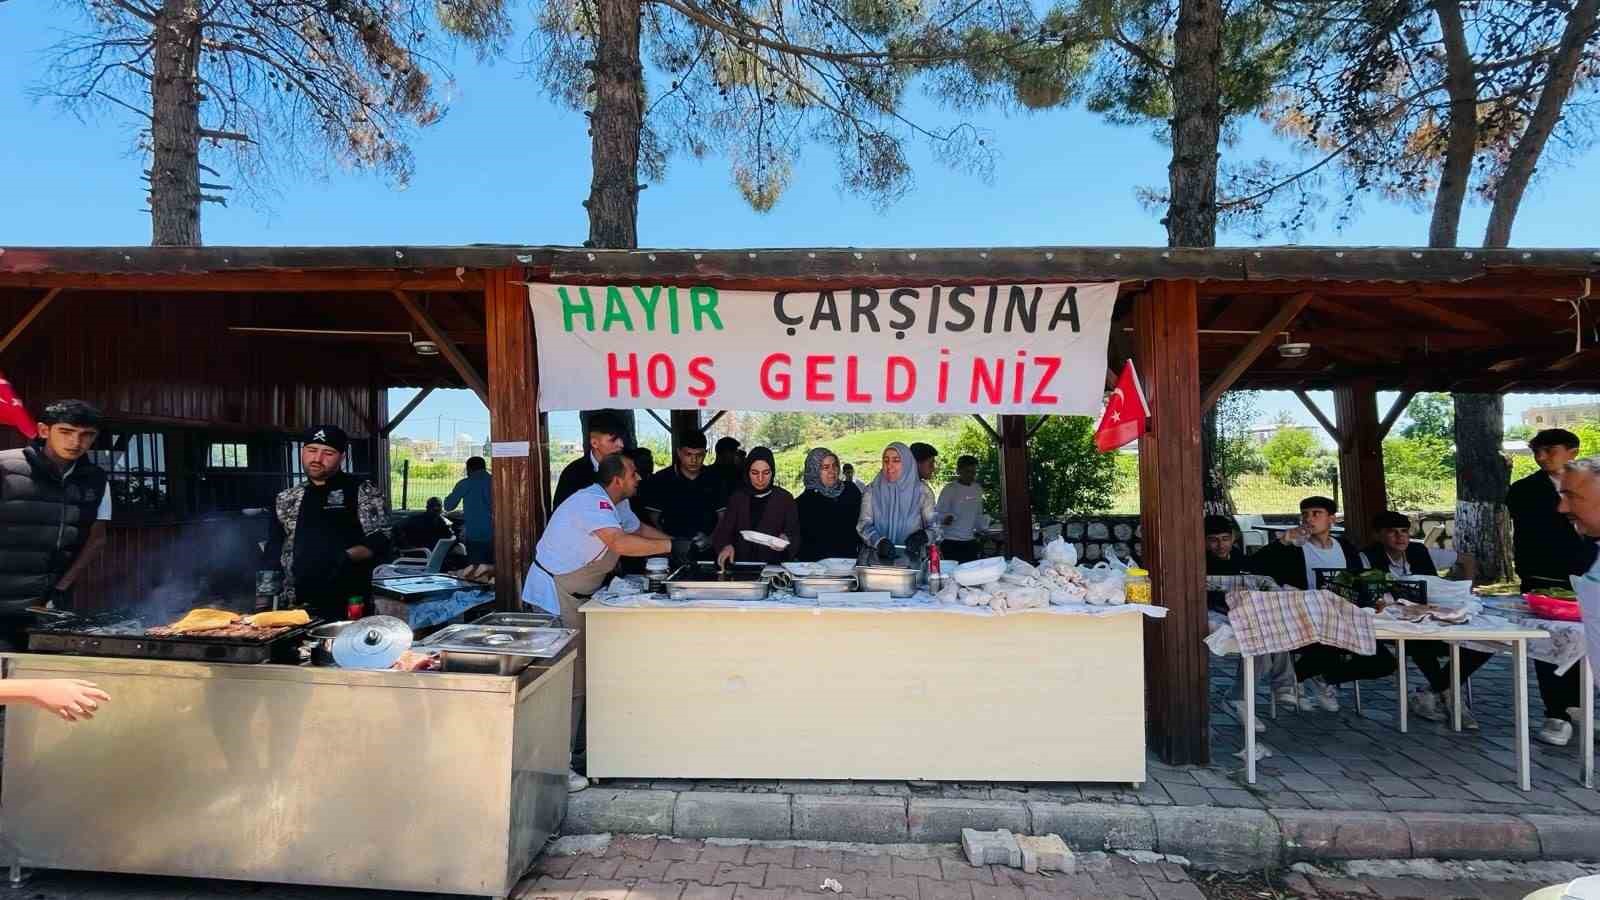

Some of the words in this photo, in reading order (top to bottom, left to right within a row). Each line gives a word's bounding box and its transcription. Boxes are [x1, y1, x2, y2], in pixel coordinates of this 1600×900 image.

[558, 285, 724, 334] HAYIR
[773, 285, 1081, 339] ÇARŞISINA
[606, 352, 717, 407] HOŞ
[759, 349, 1062, 406] GELDİNİZ
